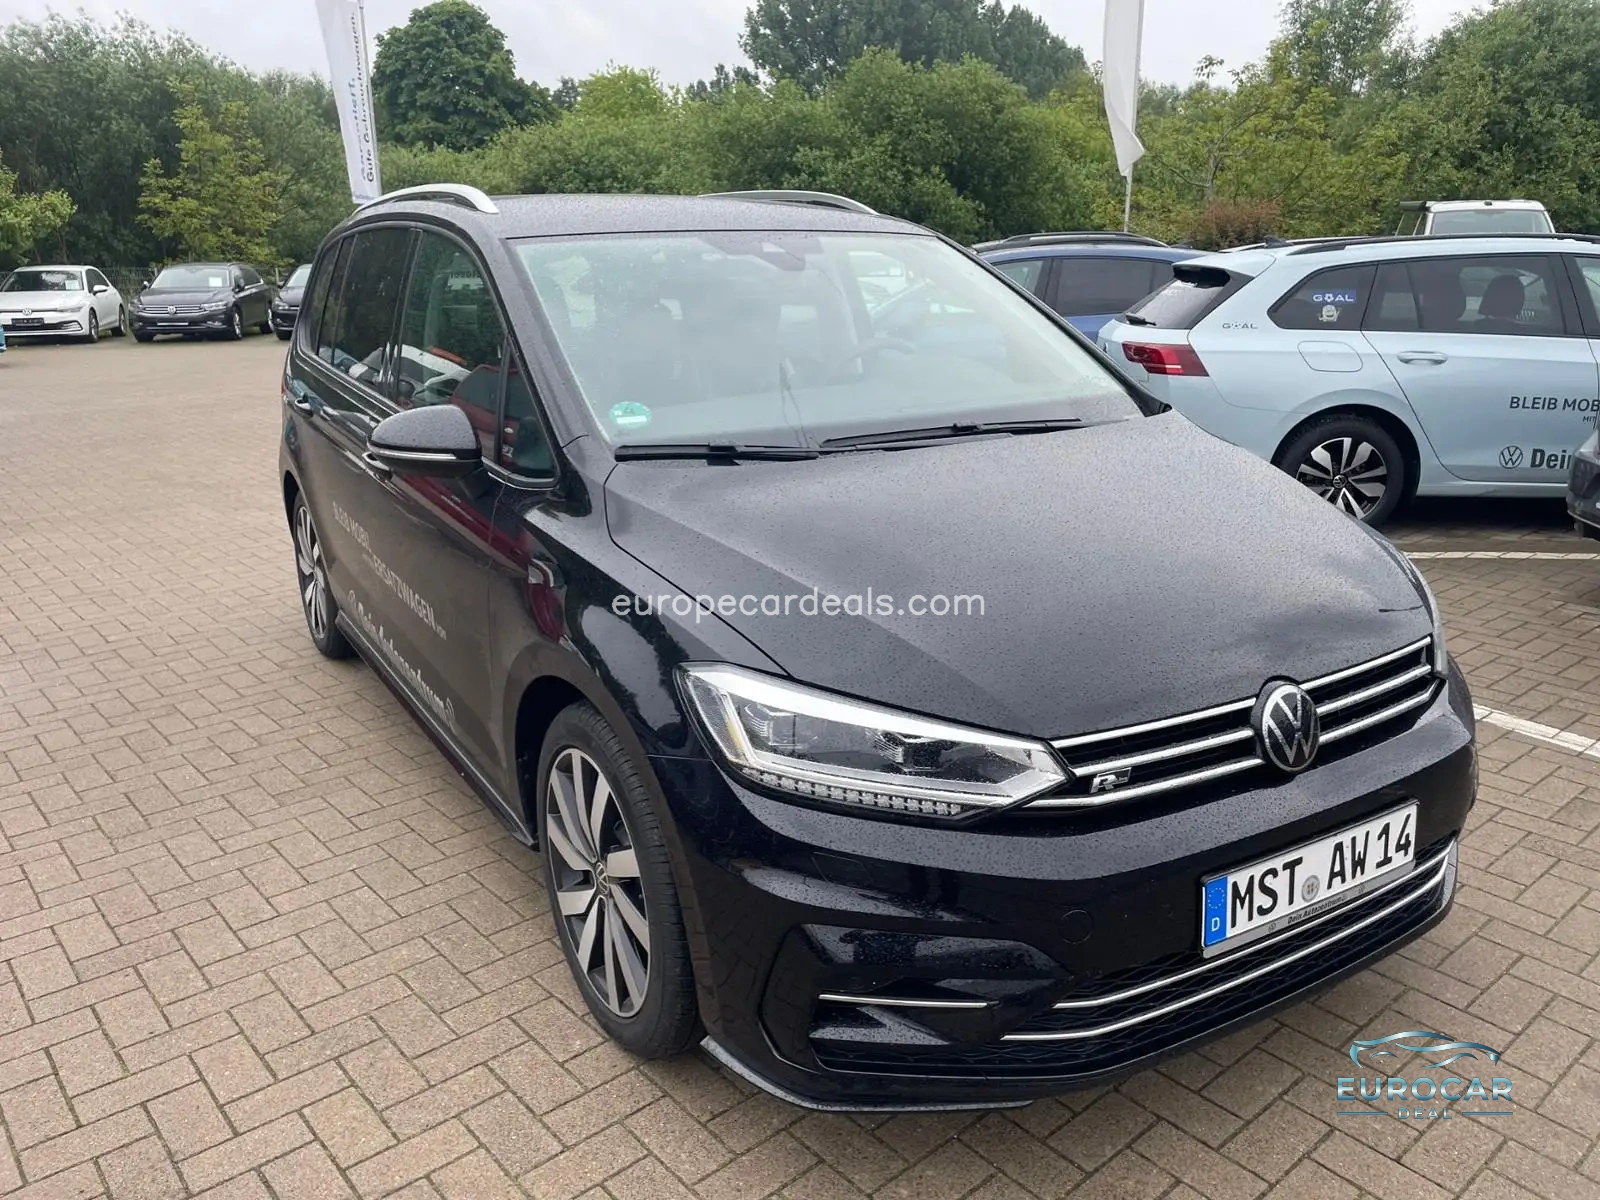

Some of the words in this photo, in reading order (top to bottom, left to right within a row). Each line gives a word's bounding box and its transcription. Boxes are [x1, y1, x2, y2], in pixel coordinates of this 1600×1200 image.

[366, 148, 375, 182] Gute
[1509, 396, 1558, 411] BLEIB
[1211, 916, 1221, 932] D
[1230, 856, 1304, 929] MST
